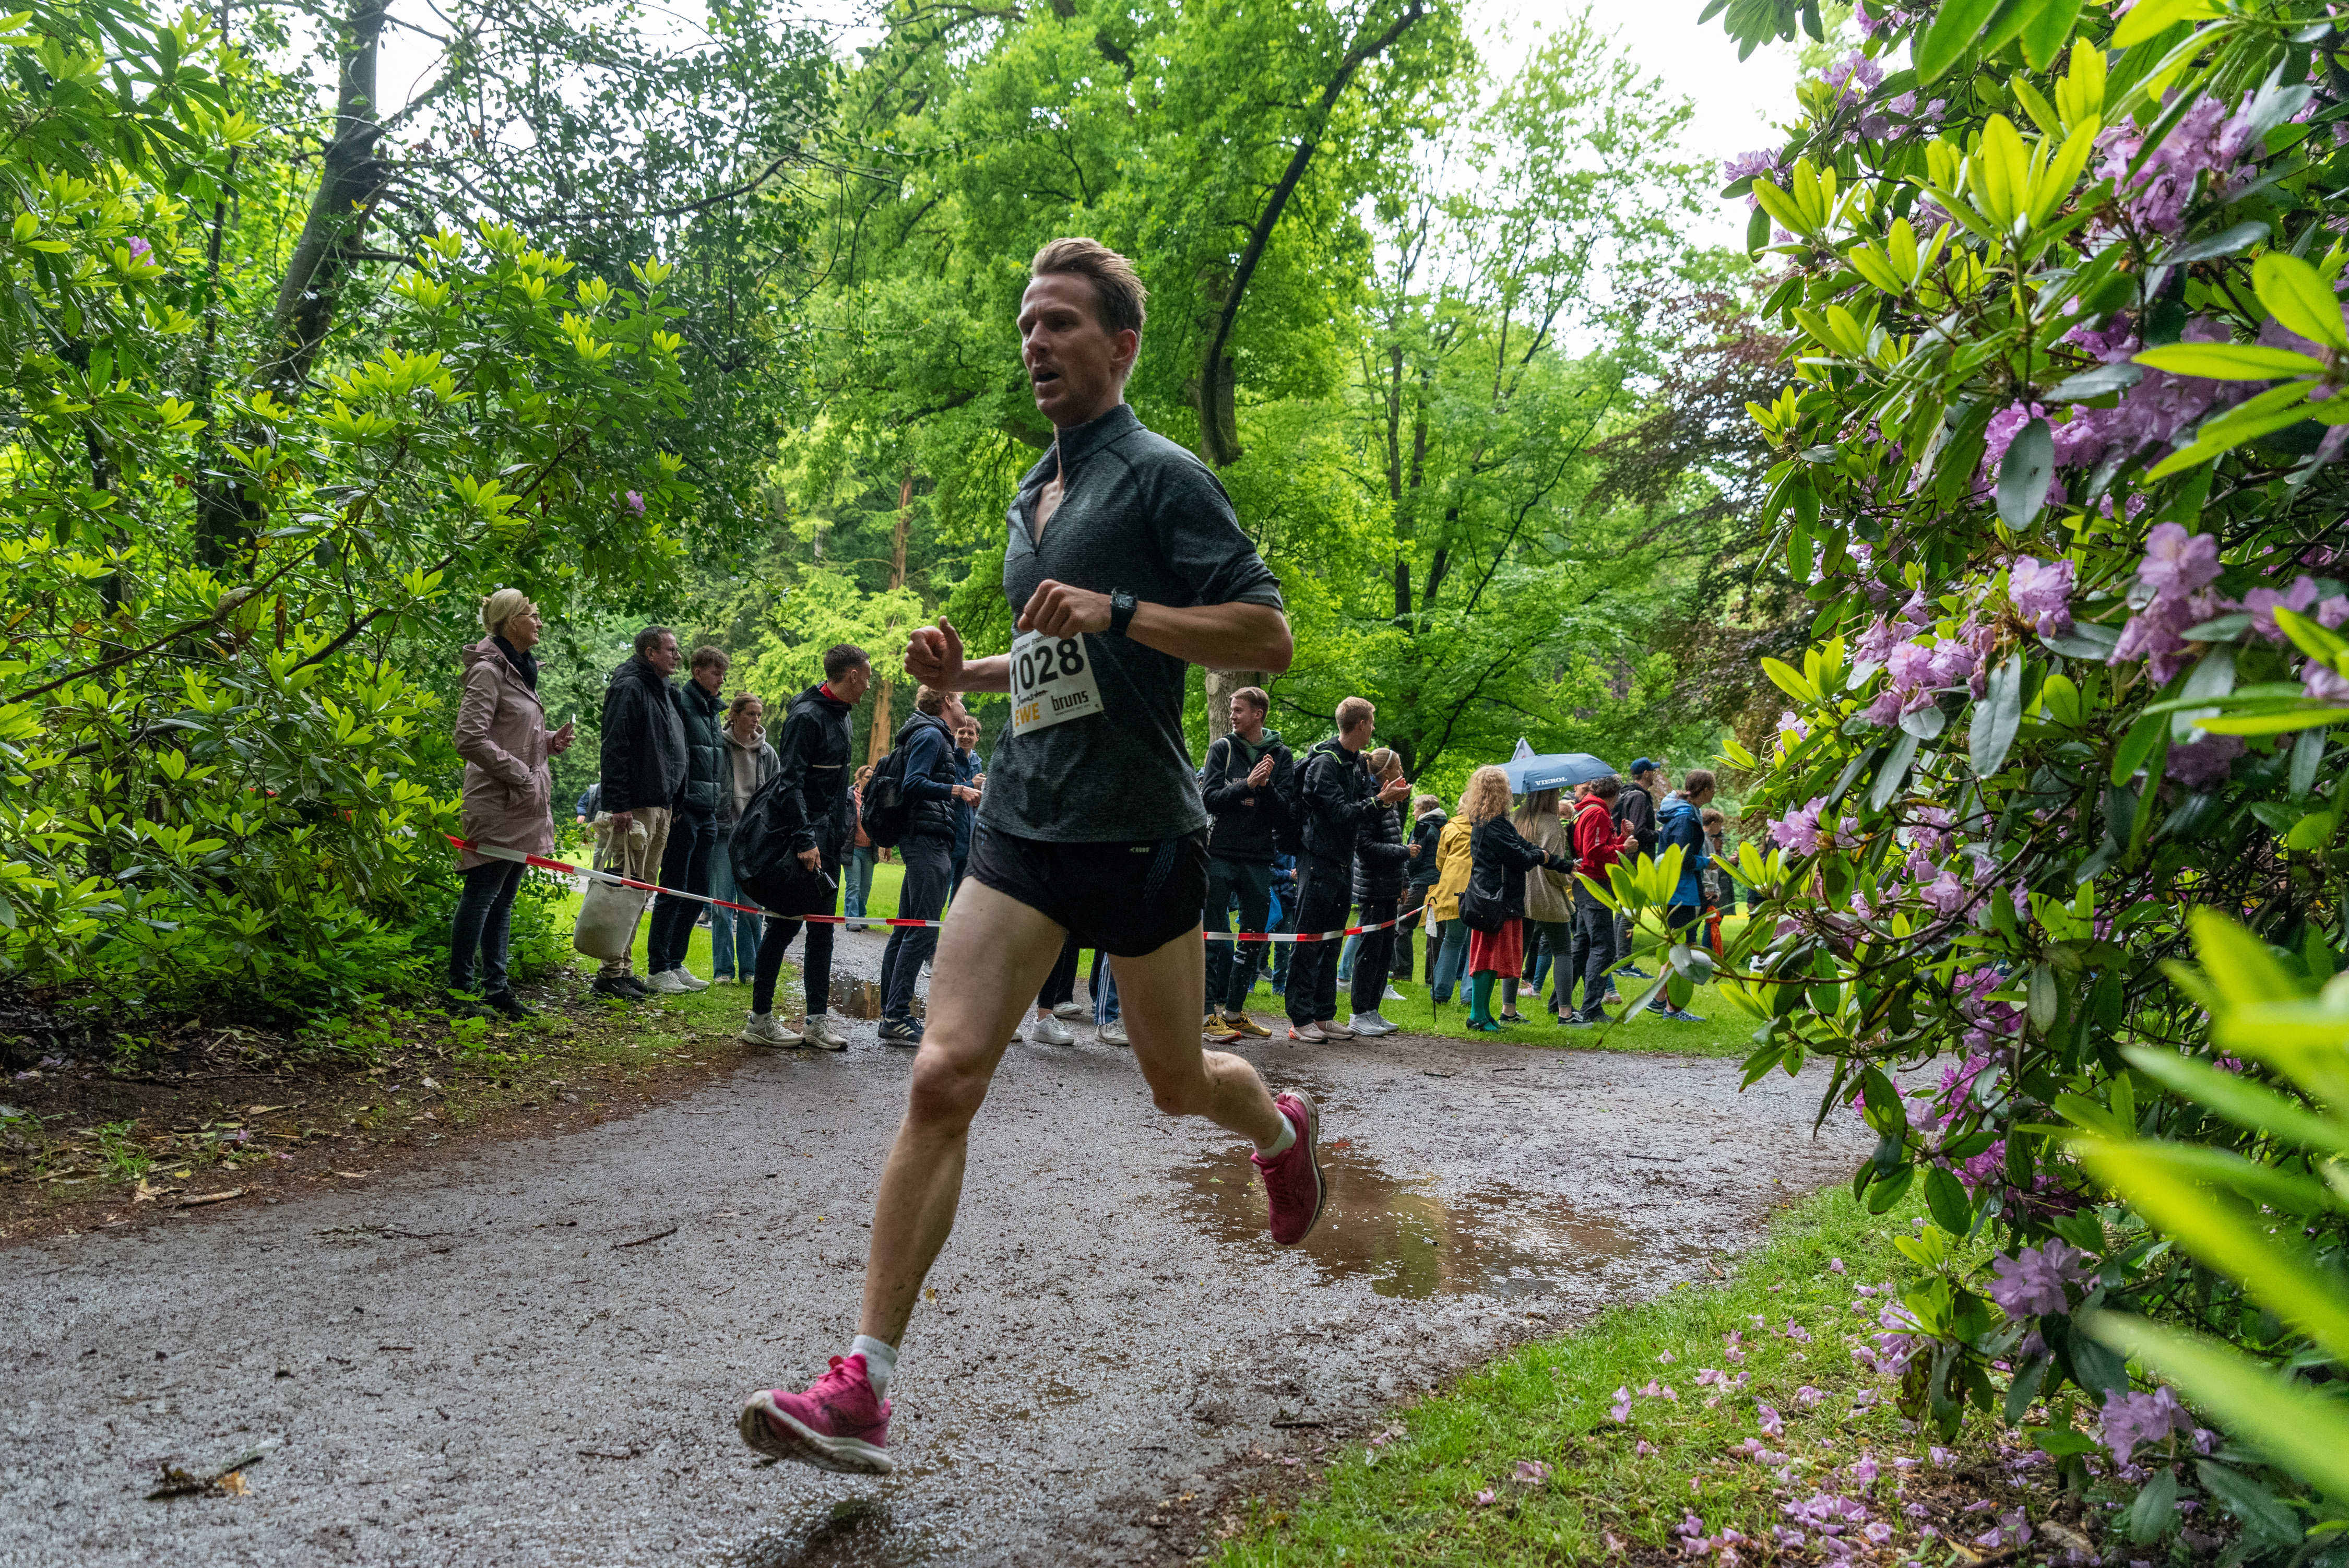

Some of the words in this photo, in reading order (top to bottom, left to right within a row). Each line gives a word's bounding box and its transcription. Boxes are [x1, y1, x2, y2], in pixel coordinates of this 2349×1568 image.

[1012, 638, 1084, 695] 1028
[1051, 690, 1089, 711] bruns
[1015, 702, 1040, 727] EWE
[1535, 777, 1567, 786] VIEROL
